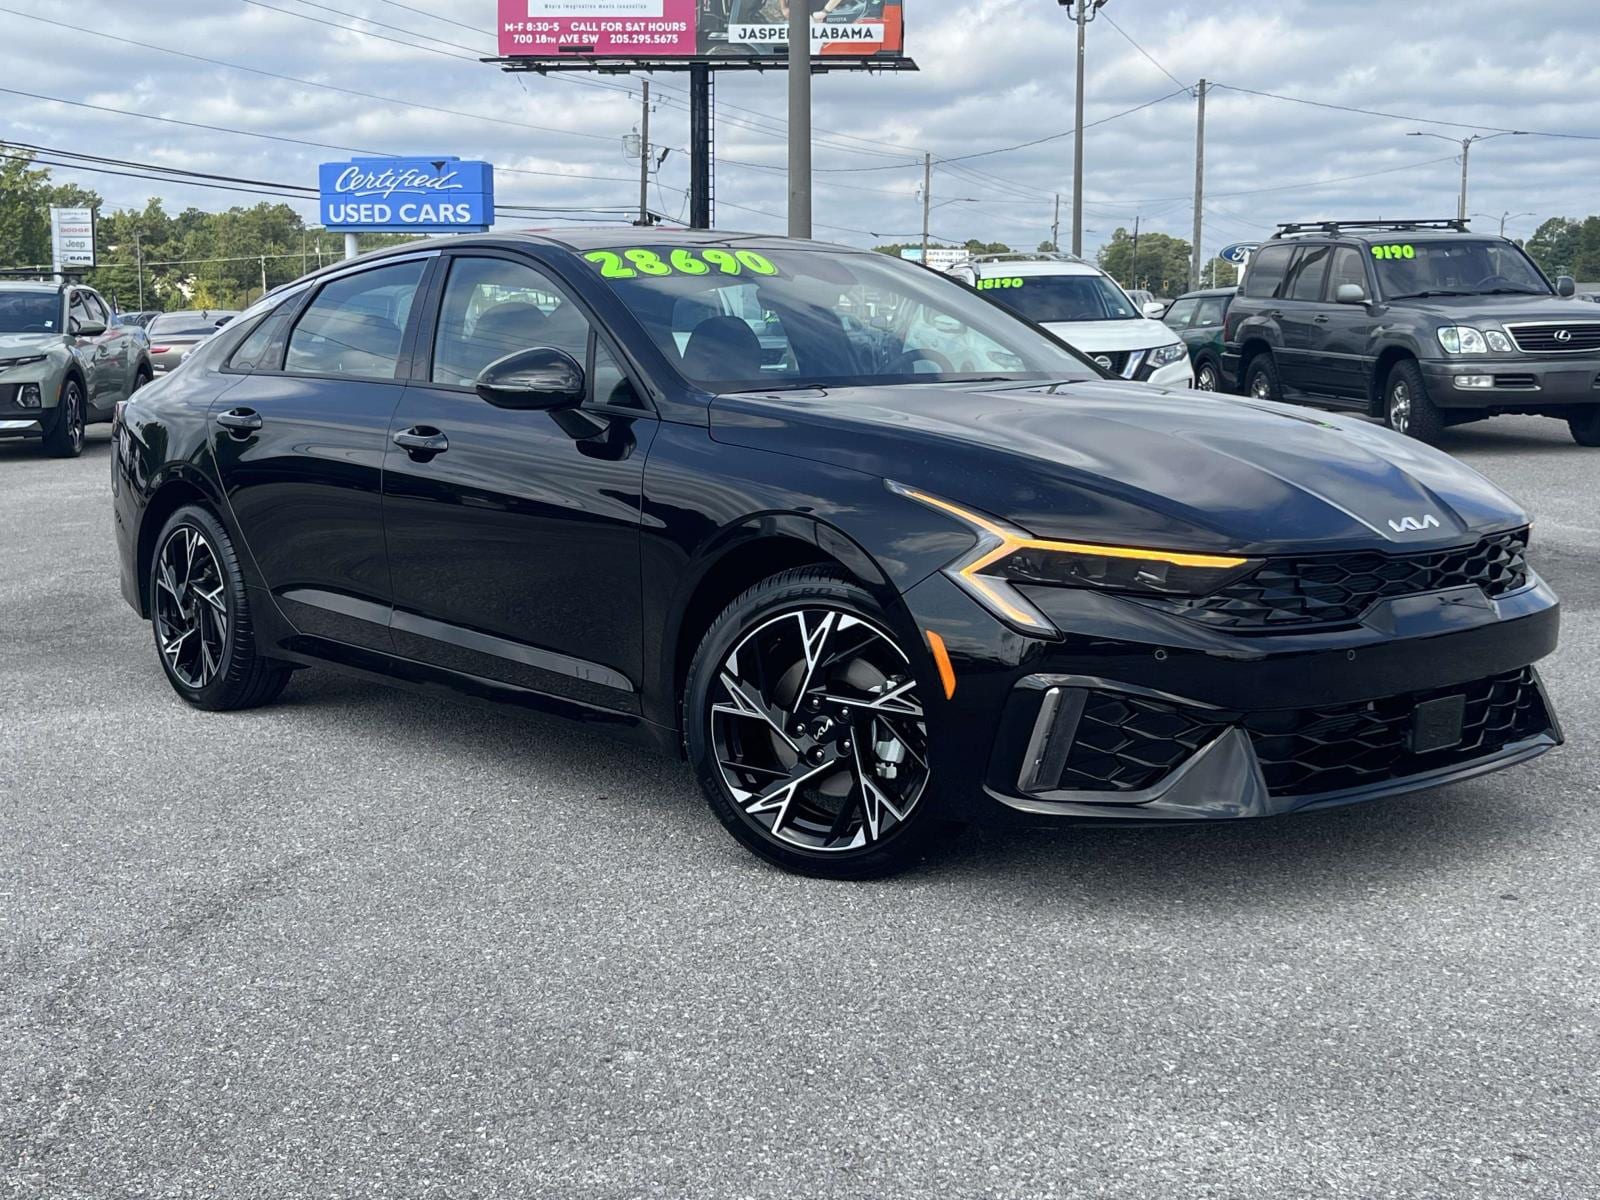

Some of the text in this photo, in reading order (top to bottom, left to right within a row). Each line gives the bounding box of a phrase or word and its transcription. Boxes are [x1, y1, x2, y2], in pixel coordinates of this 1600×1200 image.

[504, 22, 687, 32] M-F 8:30-5 CALL FOR SAT HOURS
[738, 27, 874, 40] JASPE LABAMA
[513, 34, 533, 44] 700
[558, 34, 580, 44] AVE
[581, 34, 600, 44] SW
[609, 34, 679, 44] 205.295.5675
[334, 165, 464, 200] Certified
[328, 203, 472, 224] USED CARS
[66, 240, 85, 250] Jeep
[1371, 245, 1414, 259] 9190
[584, 249, 780, 279] 28690
[976, 278, 1023, 290] 18190
[1388, 514, 1440, 532] KIA
